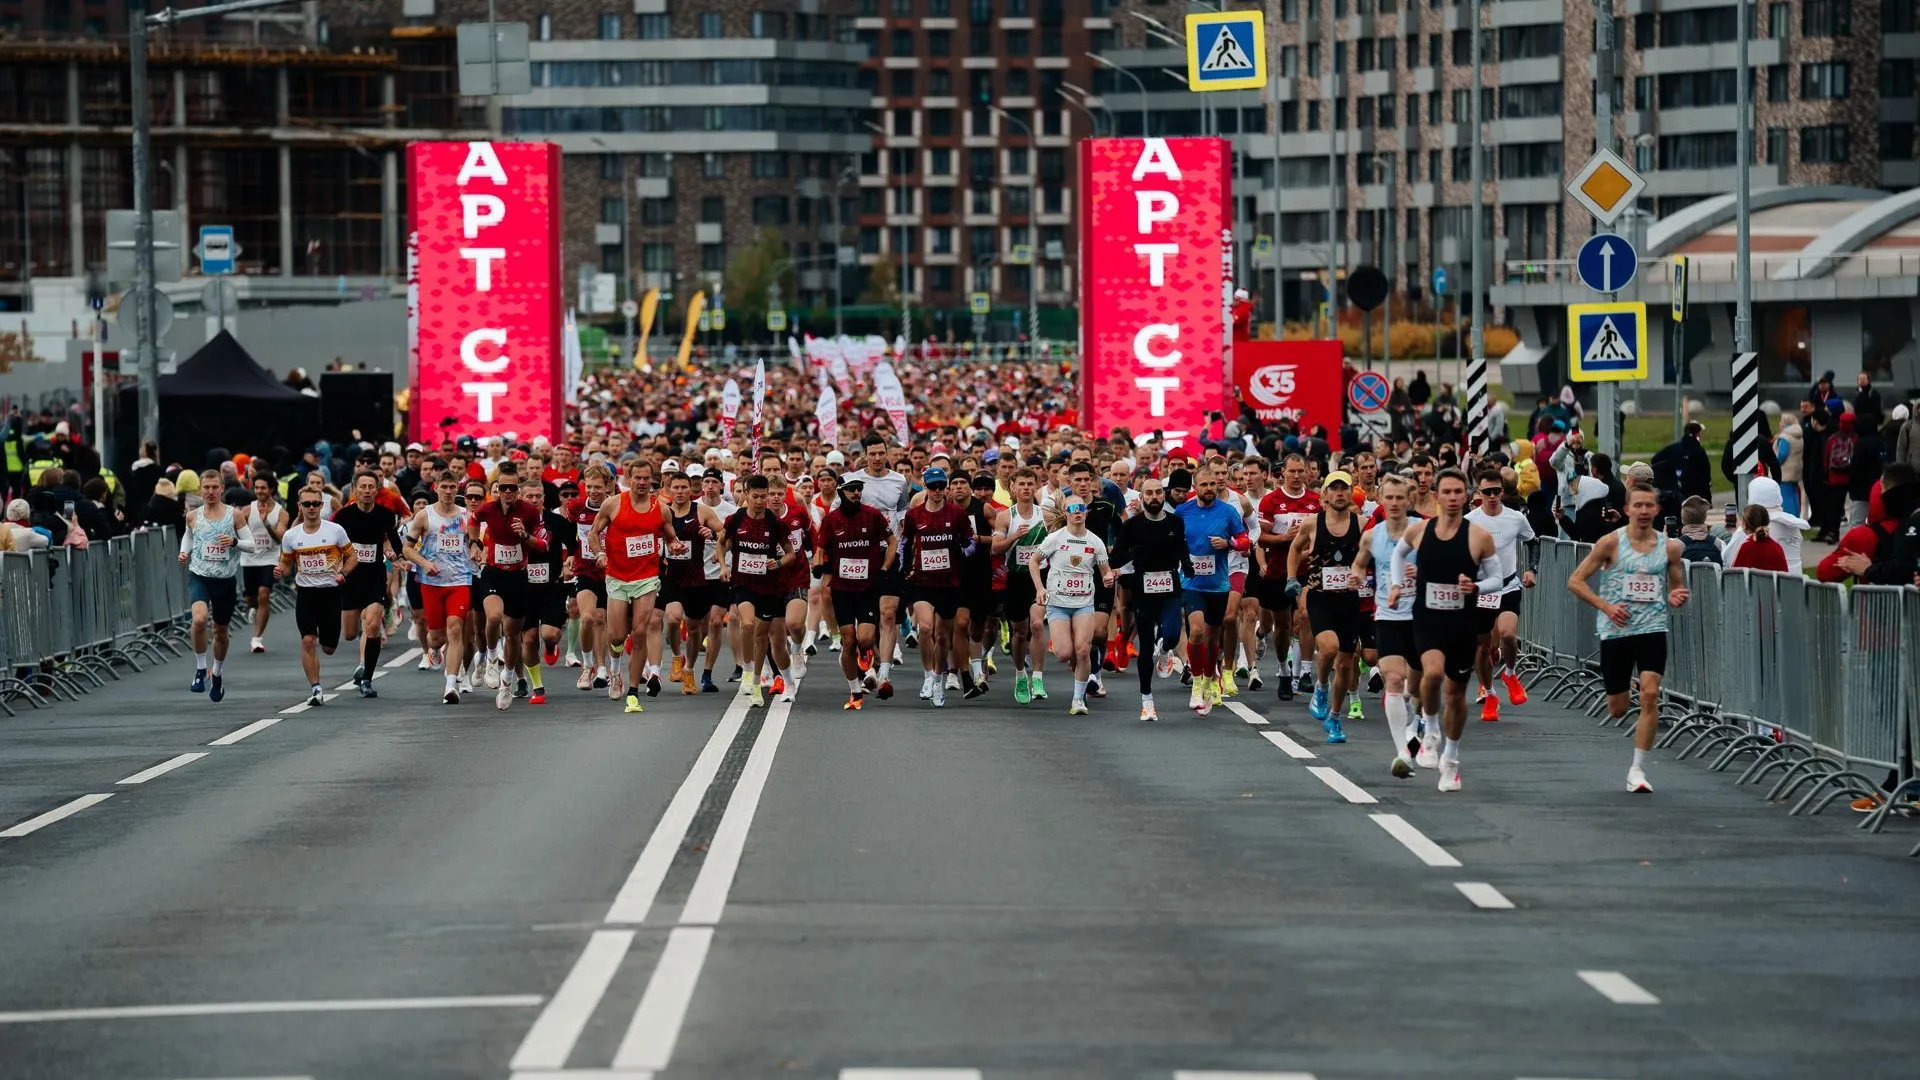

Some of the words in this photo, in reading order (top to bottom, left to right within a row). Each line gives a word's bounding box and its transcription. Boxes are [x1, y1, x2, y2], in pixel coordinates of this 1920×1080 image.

[1265, 371, 1295, 394] 35
[441, 539, 460, 547] 1613
[629, 541, 653, 552] 2868
[207, 546, 226, 554] 1715
[500, 550, 518, 558] 1117
[303, 559, 324, 568] 1036
[741, 560, 764, 569] 2457
[924, 555, 947, 565] 2405
[842, 565, 866, 574] 2487
[1195, 562, 1213, 570] 284
[1066, 580, 1084, 588] 891
[1146, 578, 1171, 587] 2448
[1628, 582, 1656, 592] 1332
[1433, 590, 1460, 600] 1318
[1479, 594, 1499, 603] 537
